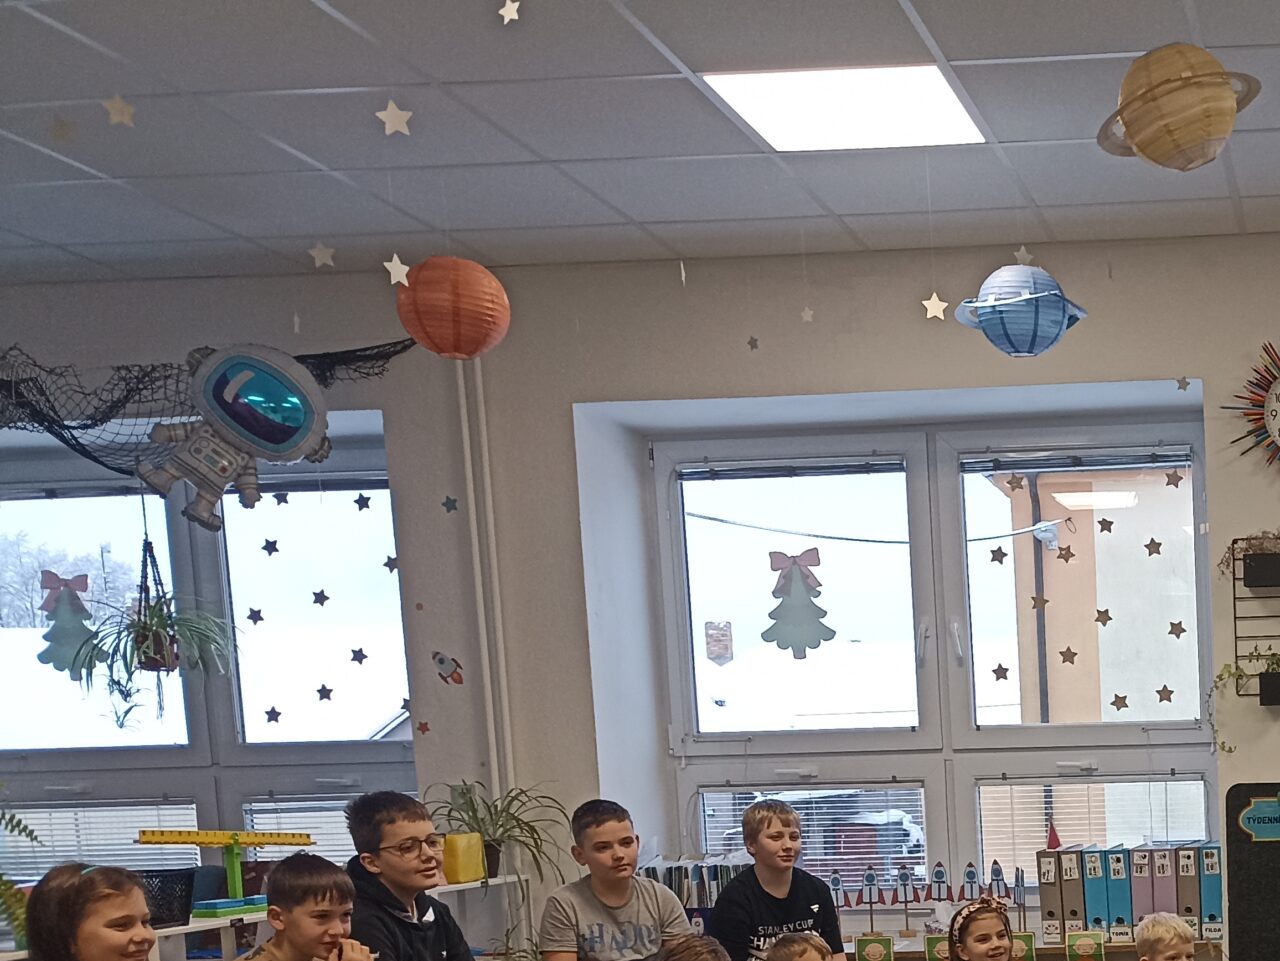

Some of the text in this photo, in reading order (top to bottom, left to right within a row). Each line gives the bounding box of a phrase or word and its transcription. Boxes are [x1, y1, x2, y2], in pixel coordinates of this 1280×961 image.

[1270, 409, 1278, 421] 9
[1246, 813, 1280, 825] TÝDENNÍ
[795, 919, 814, 930] CUP
